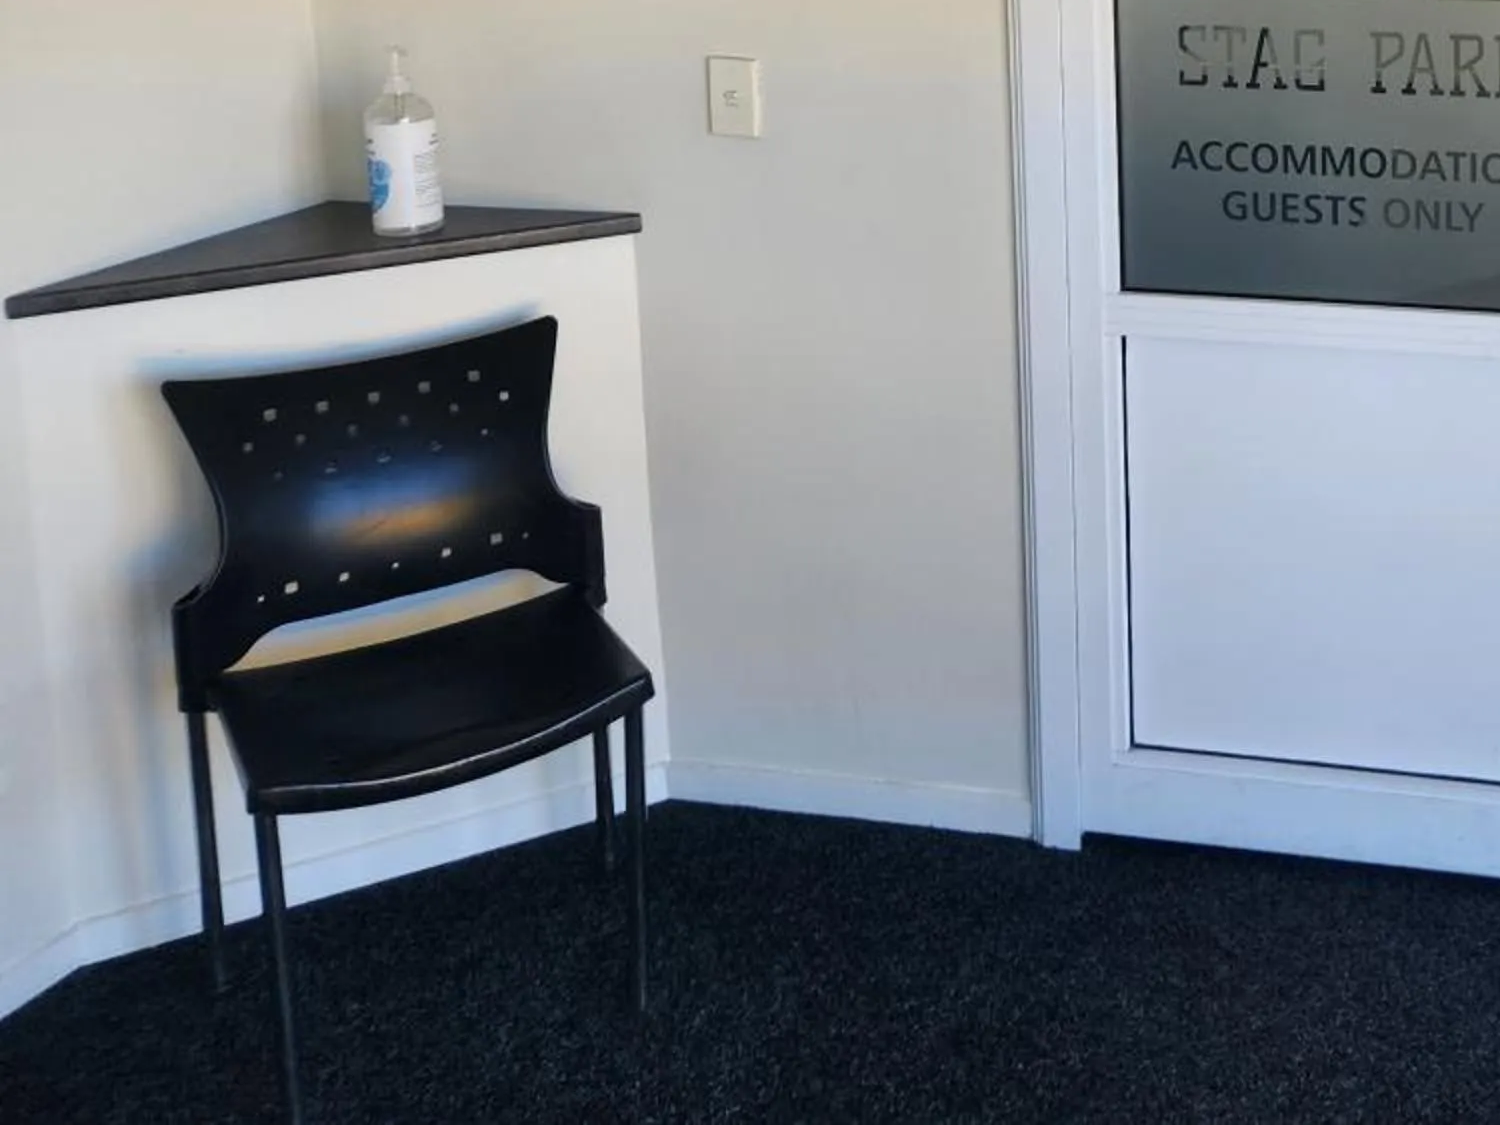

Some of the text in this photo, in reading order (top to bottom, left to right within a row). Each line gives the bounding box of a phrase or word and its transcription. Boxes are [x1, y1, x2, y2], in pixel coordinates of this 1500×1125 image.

[1178, 24, 1326, 92] STAG
[1221, 190, 1486, 233] GUESTS ONLY
